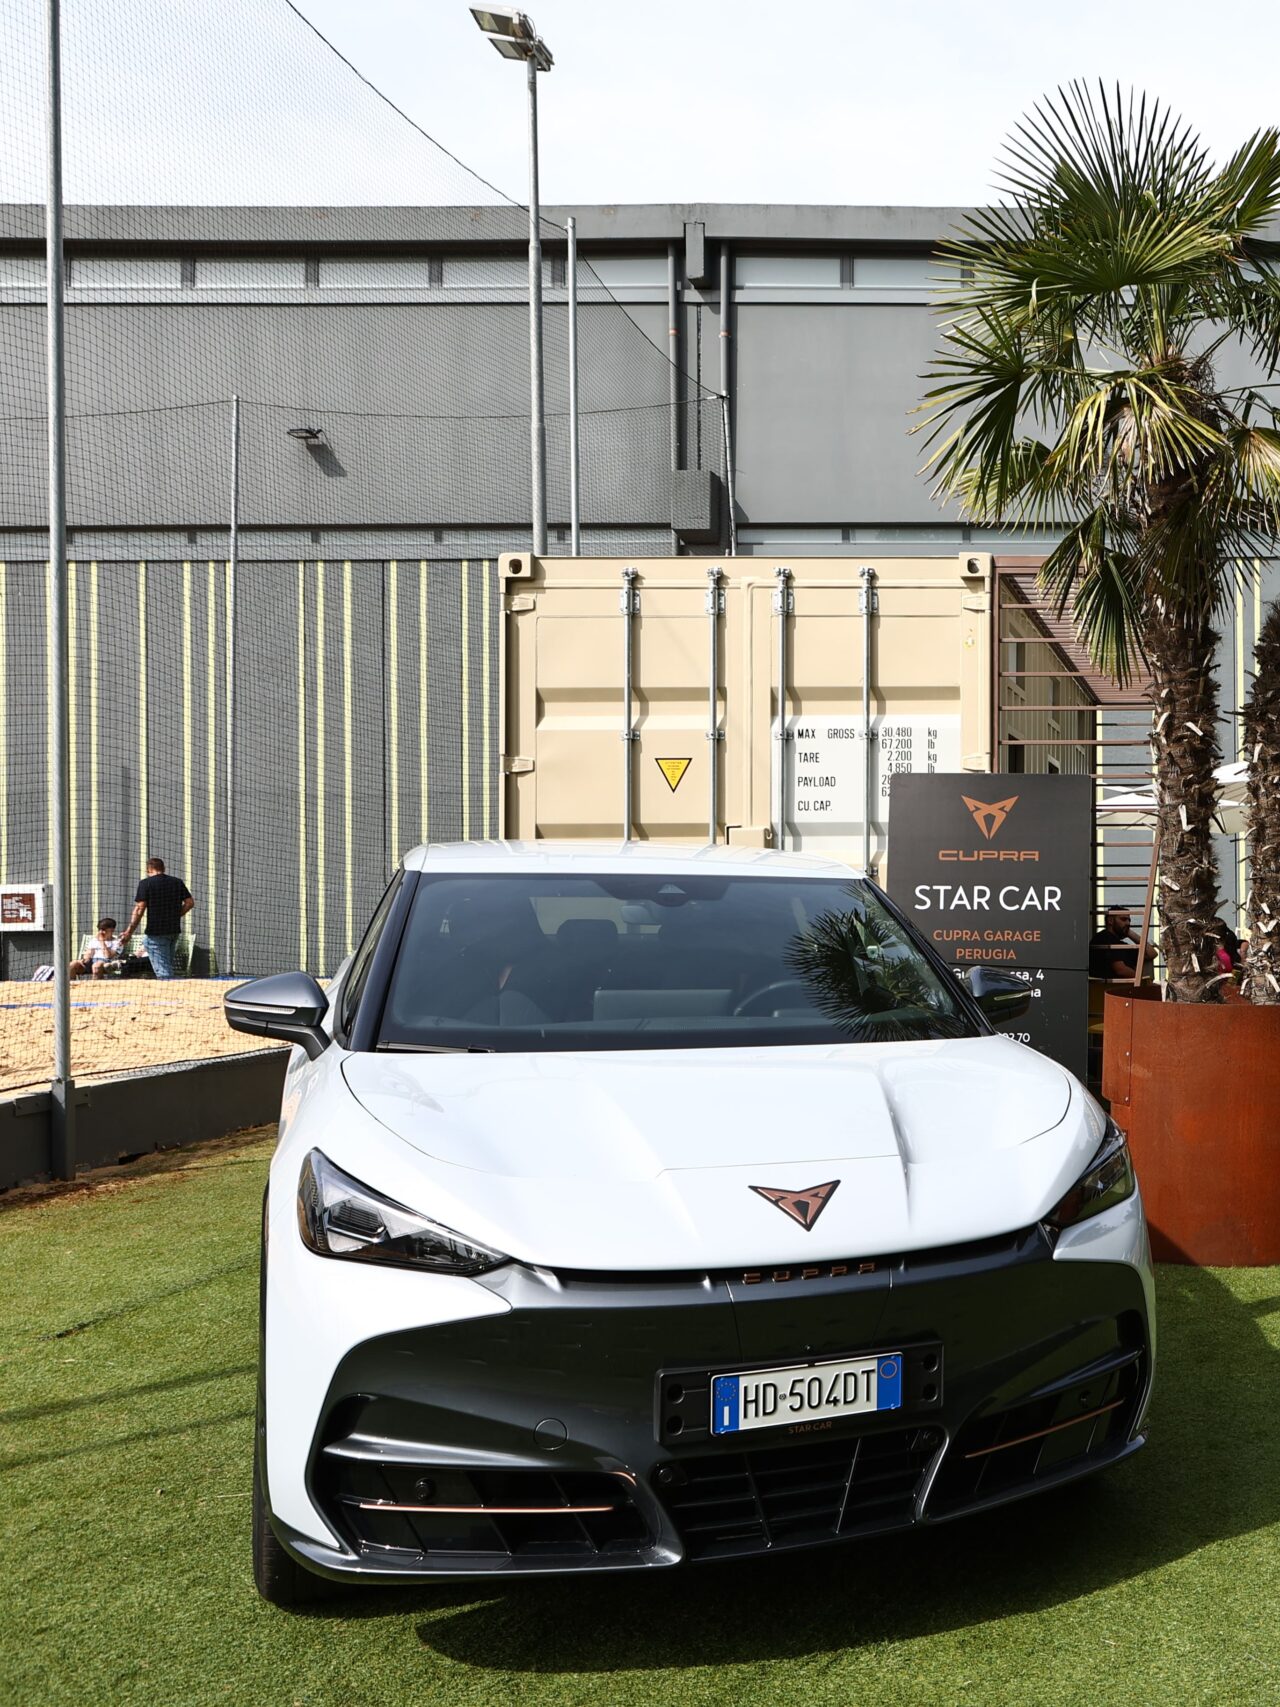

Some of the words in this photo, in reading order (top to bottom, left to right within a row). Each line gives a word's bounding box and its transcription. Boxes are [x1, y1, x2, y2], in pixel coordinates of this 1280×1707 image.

[797, 728, 816, 739] MAX
[827, 728, 855, 739] GROSS
[881, 727, 912, 738] 30.480
[927, 728, 937, 740] kg
[881, 739, 912, 750] 67.200
[927, 739, 935, 750] lb
[798, 752, 820, 763] TARE
[887, 751, 912, 762] 2.200
[927, 751, 937, 763] kg
[887, 763, 912, 773] 4.850
[927, 763, 935, 773] lb
[797, 776, 836, 788] PAYLOAD
[797, 800, 812, 812] CU.
[813, 800, 833, 812] CAP.
[938, 849, 1040, 862] CUPRA
[914, 884, 991, 911] STAR
[998, 885, 1062, 911] CAR
[932, 929, 982, 942] CUPRA
[983, 930, 1041, 942] GARAGE
[955, 947, 1017, 960] PERUGIA
[742, 1262, 876, 1285] CUPRA
[787, 1423, 811, 1435] STAR
[812, 1420, 833, 1432] CAR
